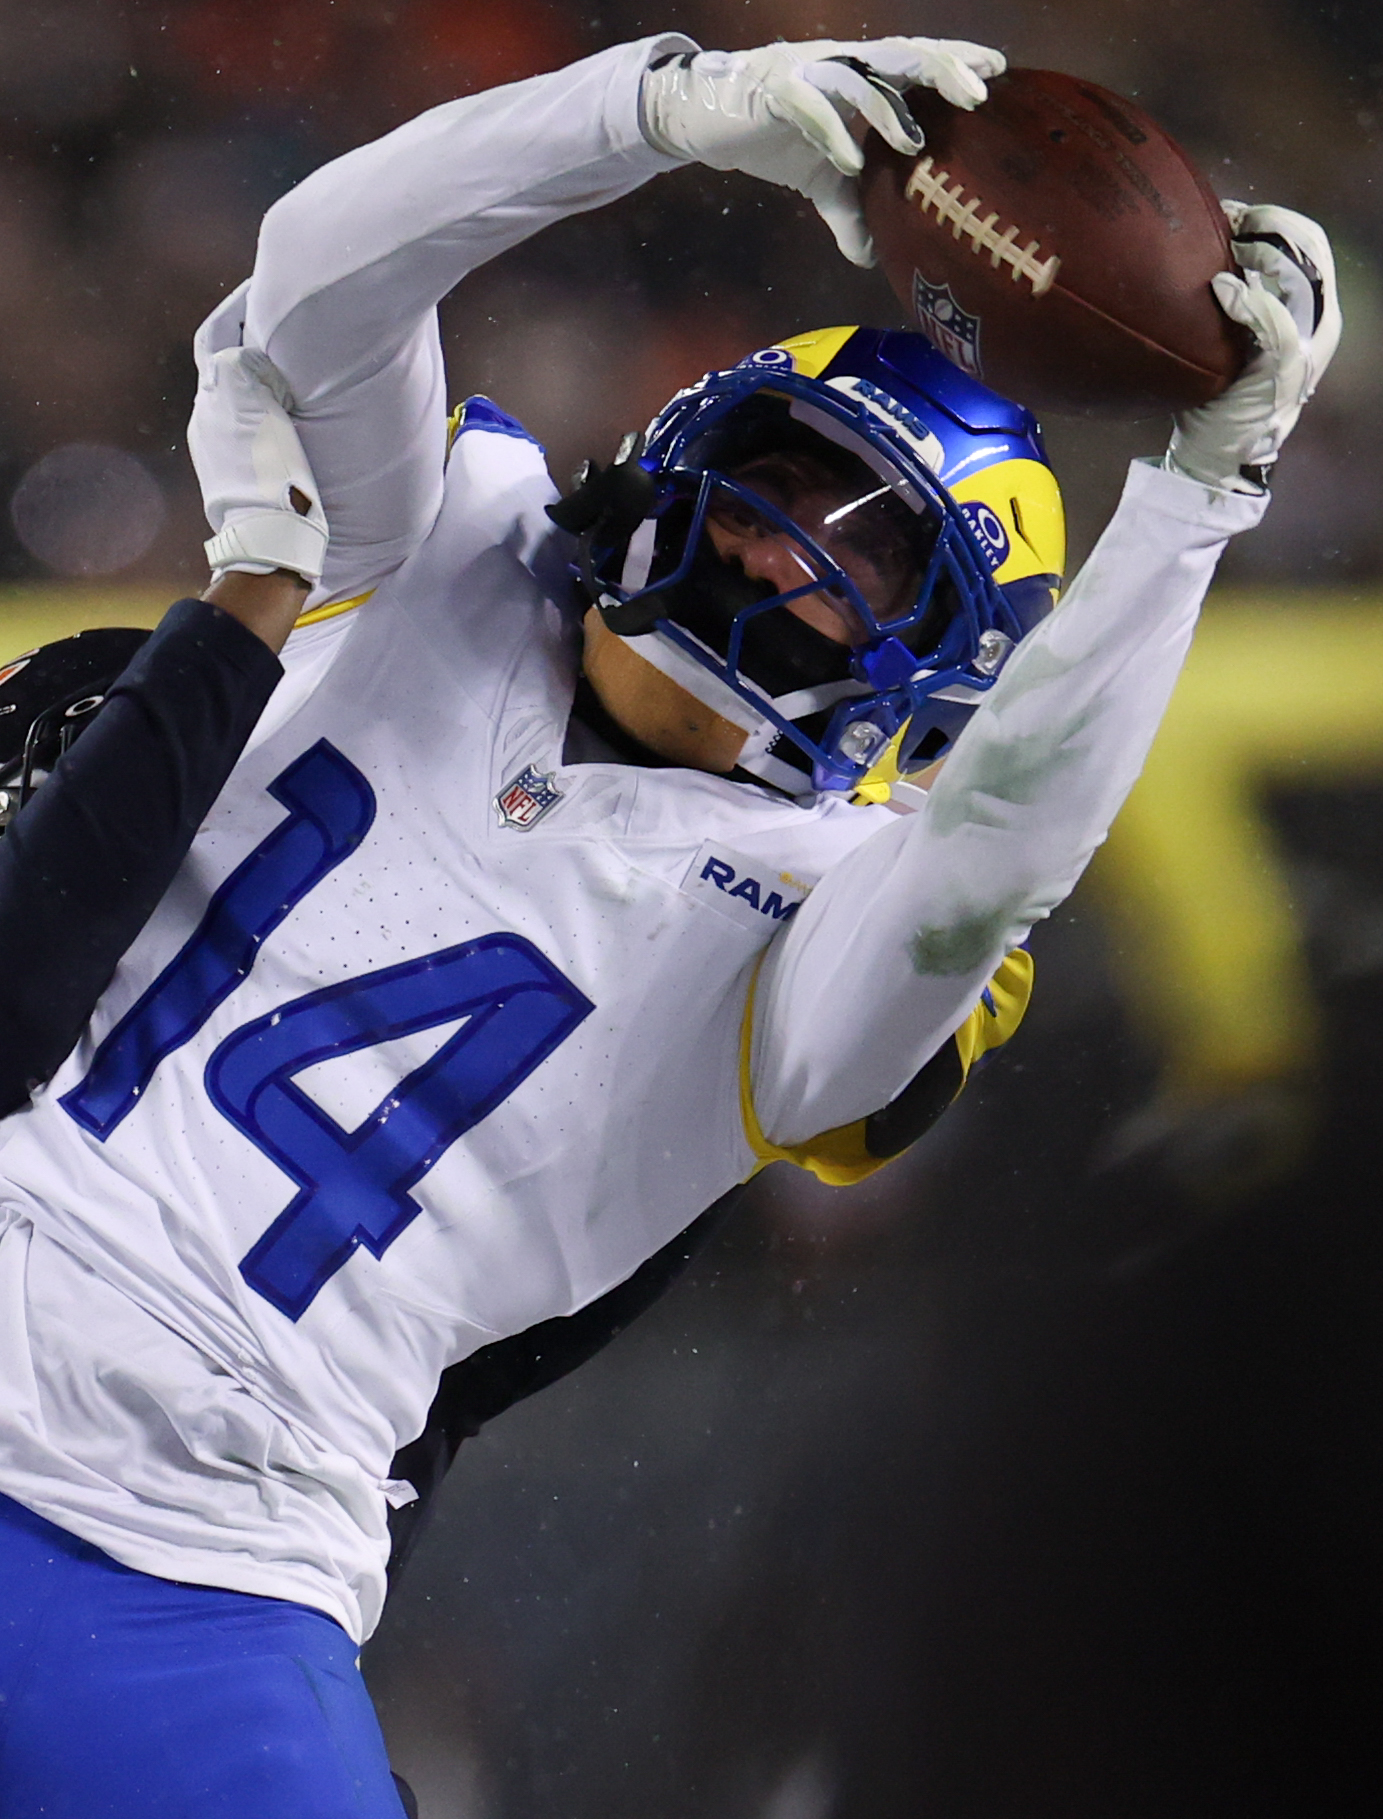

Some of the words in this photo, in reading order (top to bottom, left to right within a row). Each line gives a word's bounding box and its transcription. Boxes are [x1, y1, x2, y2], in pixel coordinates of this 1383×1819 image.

[851, 378, 930, 442] RAMS
[961, 507, 1000, 567] OAKLEY
[501, 785, 538, 822] NFL
[699, 855, 801, 922] RAM
[59, 736, 597, 1324] 14
